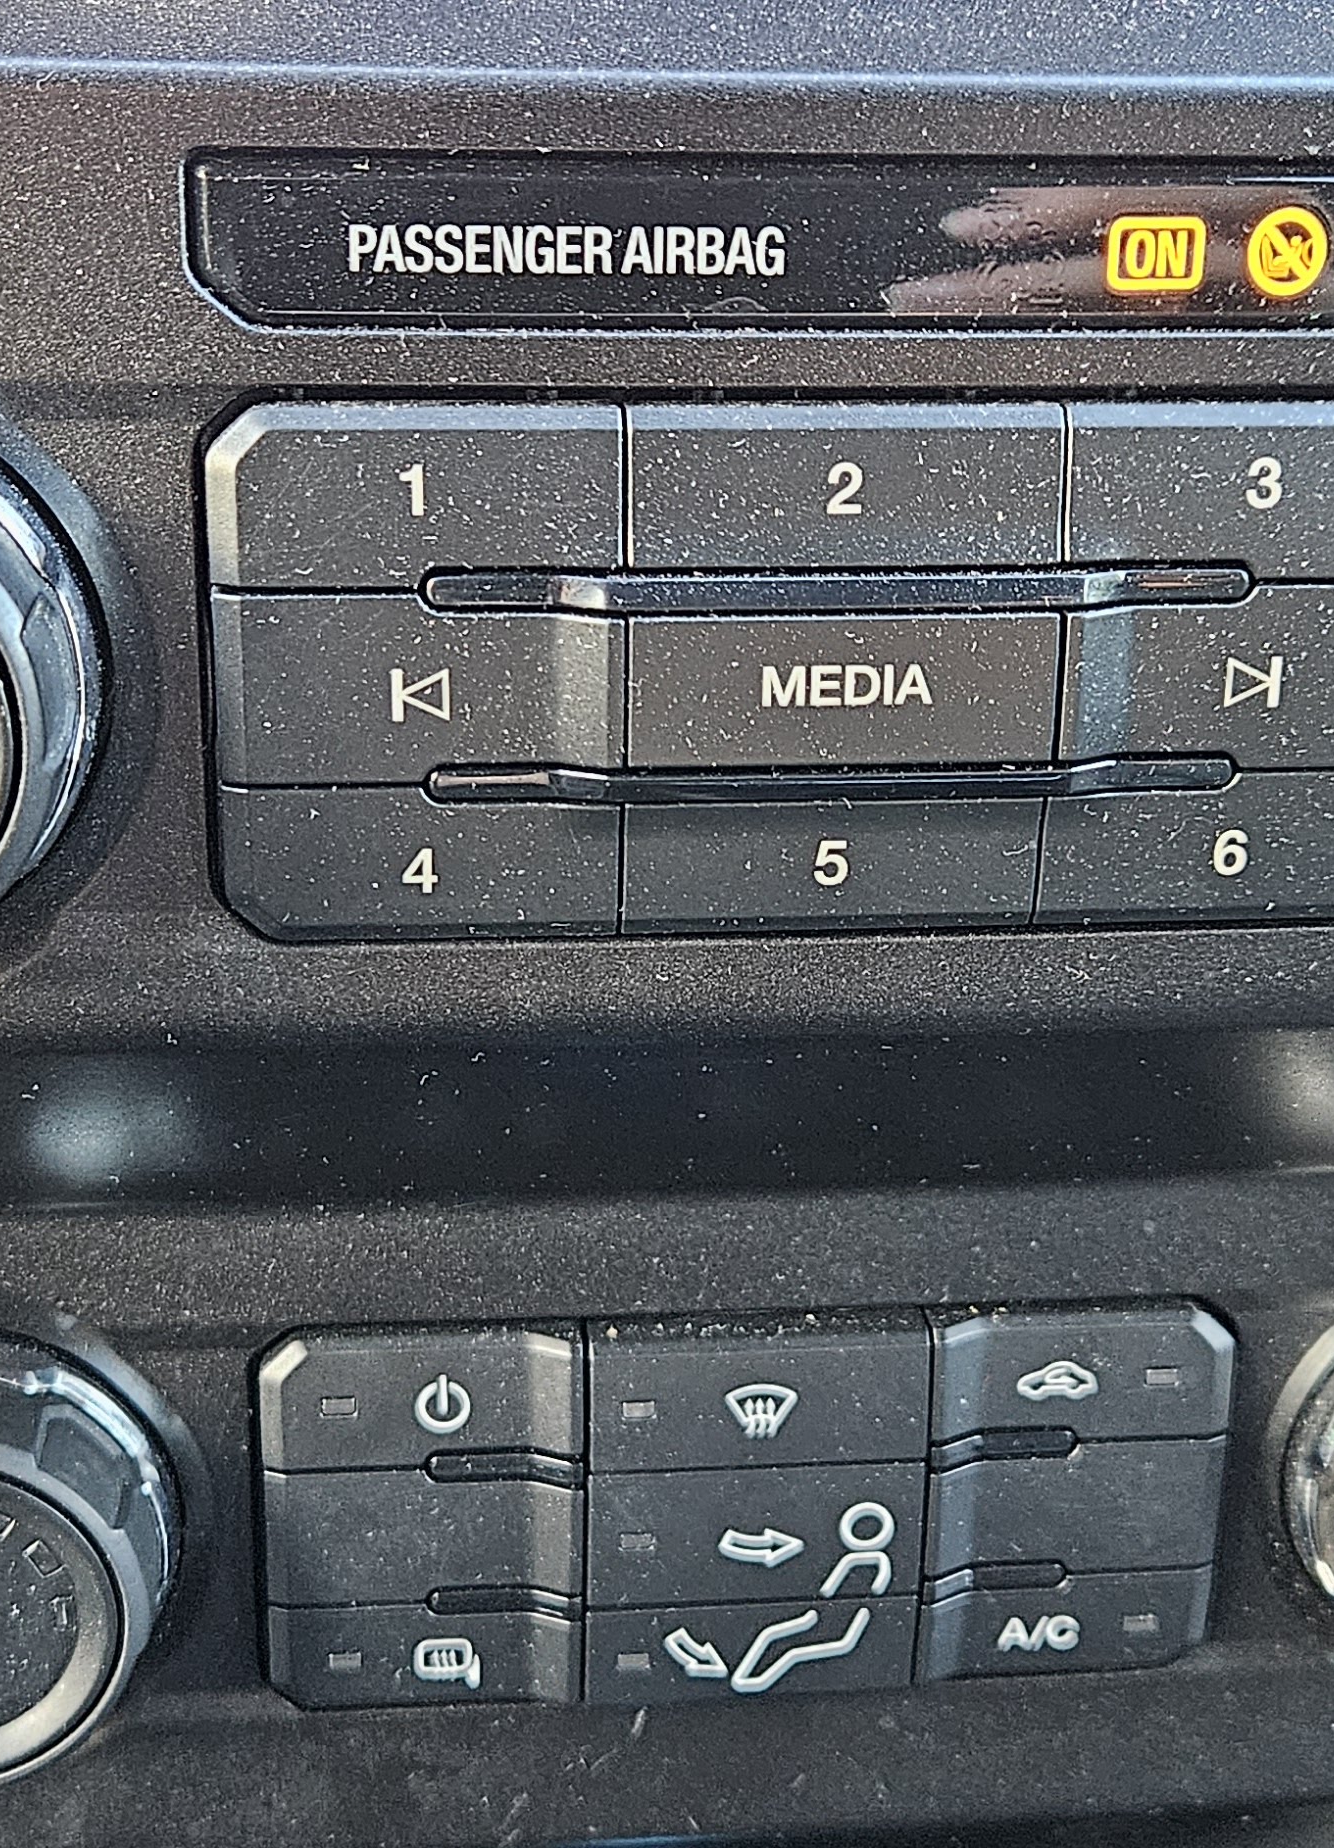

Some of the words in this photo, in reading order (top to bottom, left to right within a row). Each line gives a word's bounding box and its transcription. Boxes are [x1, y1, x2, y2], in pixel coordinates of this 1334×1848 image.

[348, 224, 613, 274] PASSENGER
[620, 225, 786, 276] AIRBAG
[1125, 229, 1189, 278] ON
[398, 463, 424, 516] 1
[826, 461, 863, 515] 2
[1245, 456, 1283, 510] 3
[761, 663, 934, 708] MEDIA
[401, 848, 438, 894] 4
[813, 840, 848, 886] 5
[1212, 829, 1248, 876] 6
[997, 1614, 1081, 1652] A/C
